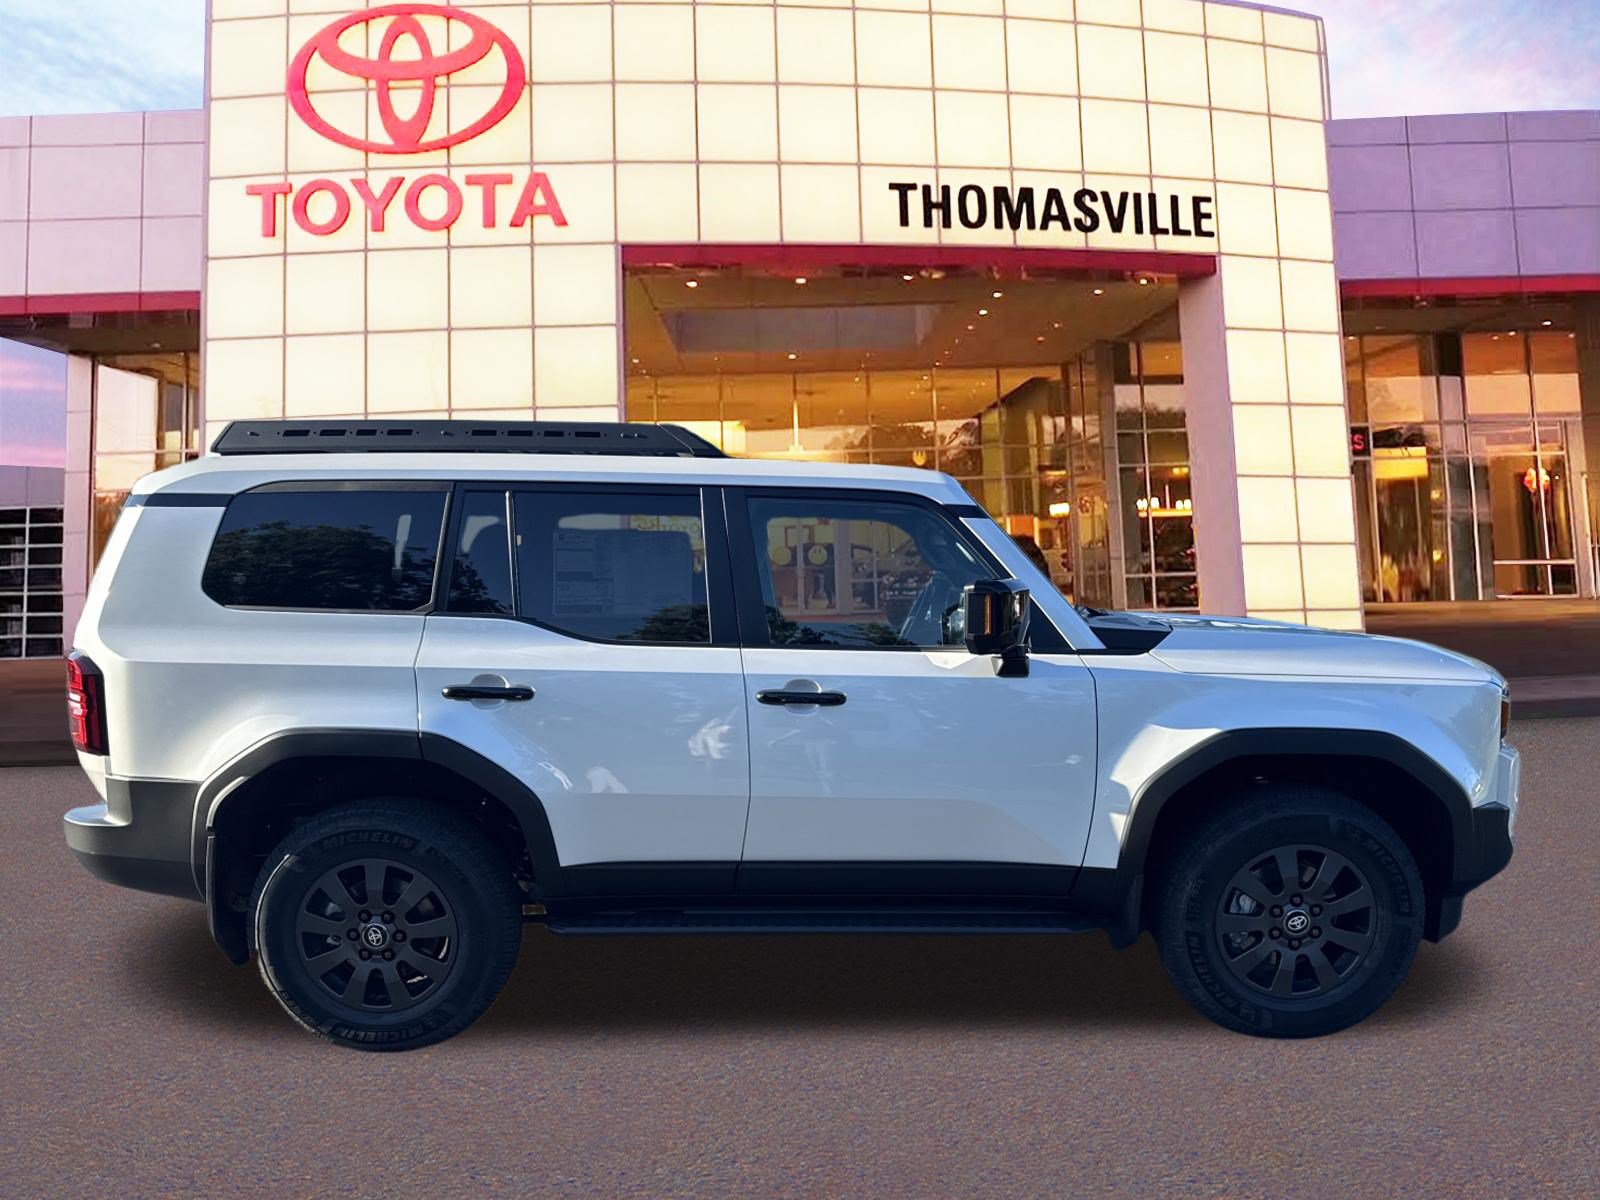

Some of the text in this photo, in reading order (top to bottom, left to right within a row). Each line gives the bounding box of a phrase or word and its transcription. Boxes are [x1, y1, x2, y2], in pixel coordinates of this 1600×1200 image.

[246, 172, 568, 237] TOYOTA
[889, 182, 1215, 237] THOMASVILLE
[323, 831, 414, 849] MICHELIN
